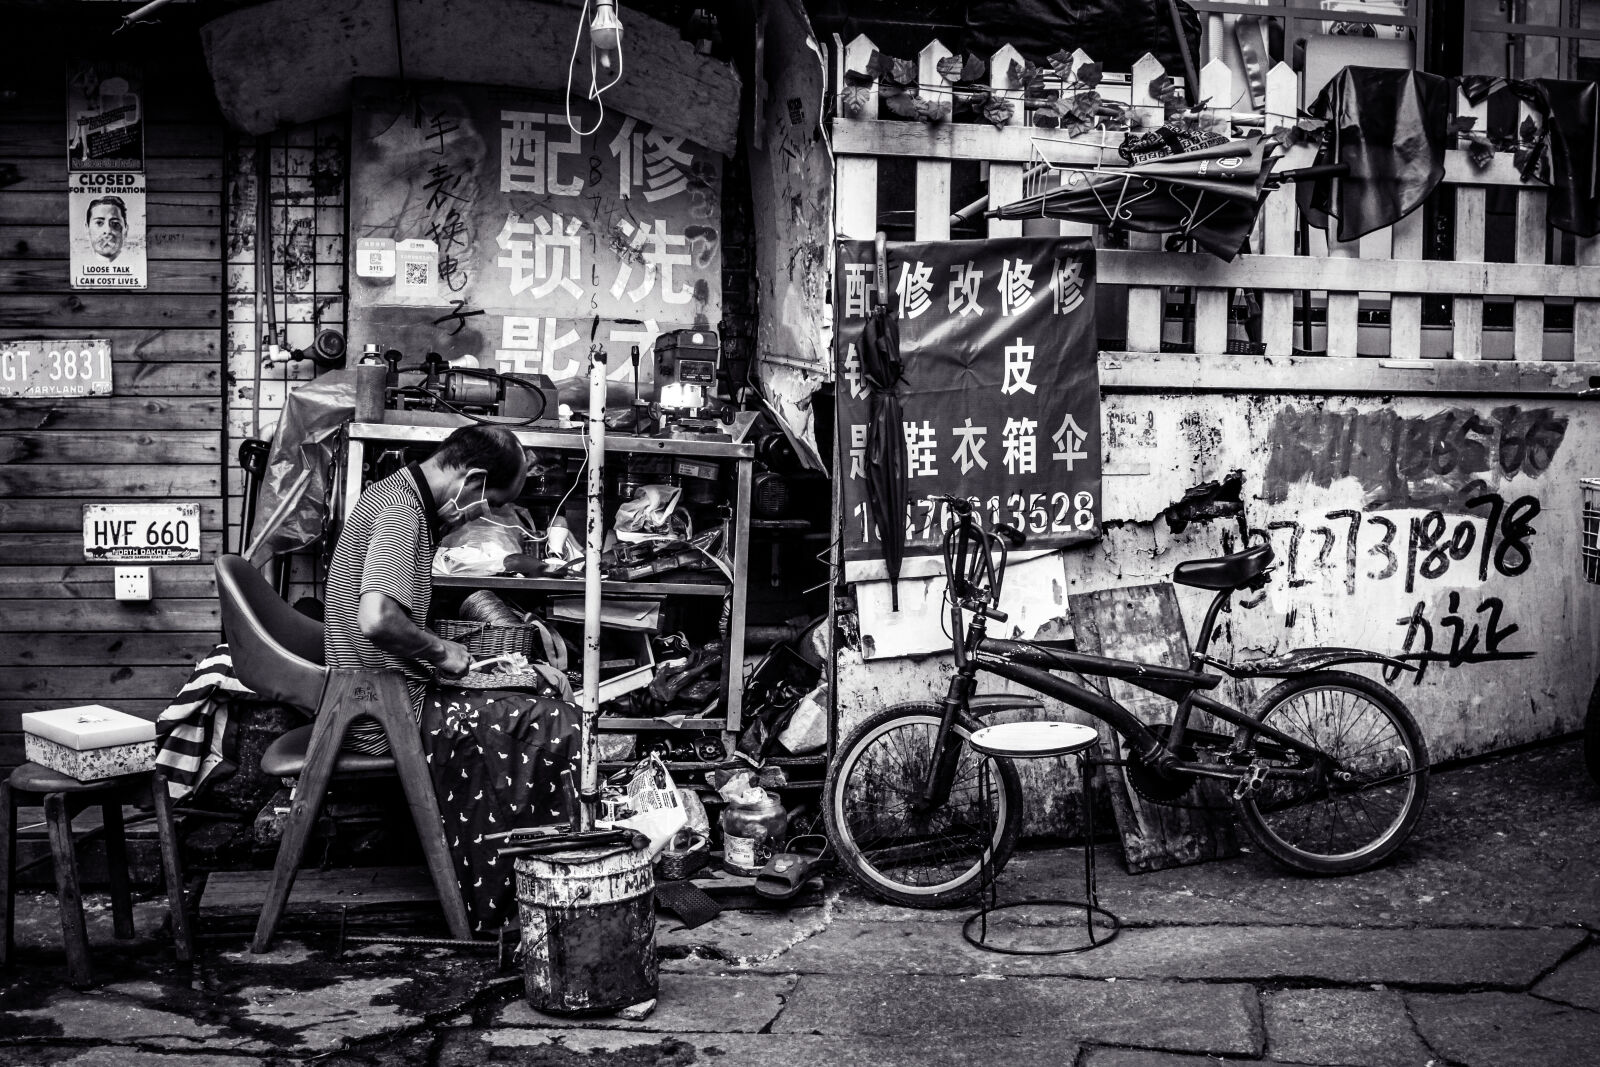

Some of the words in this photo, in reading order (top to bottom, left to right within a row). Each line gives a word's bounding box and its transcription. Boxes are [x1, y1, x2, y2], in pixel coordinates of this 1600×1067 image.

[79, 174, 135, 186] CLOSED
[80, 277, 95, 285] CAN
[97, 277, 115, 285] COST
[118, 277, 139, 285] LIVES
[1, 350, 31, 381] GT
[48, 349, 105, 380] 3831
[25, 385, 84, 393] MARYLAND
[94, 520, 137, 546] HVF
[146, 520, 189, 545] 660
[112, 548, 139, 556] NORTH
[141, 548, 172, 556] DAKOTA
